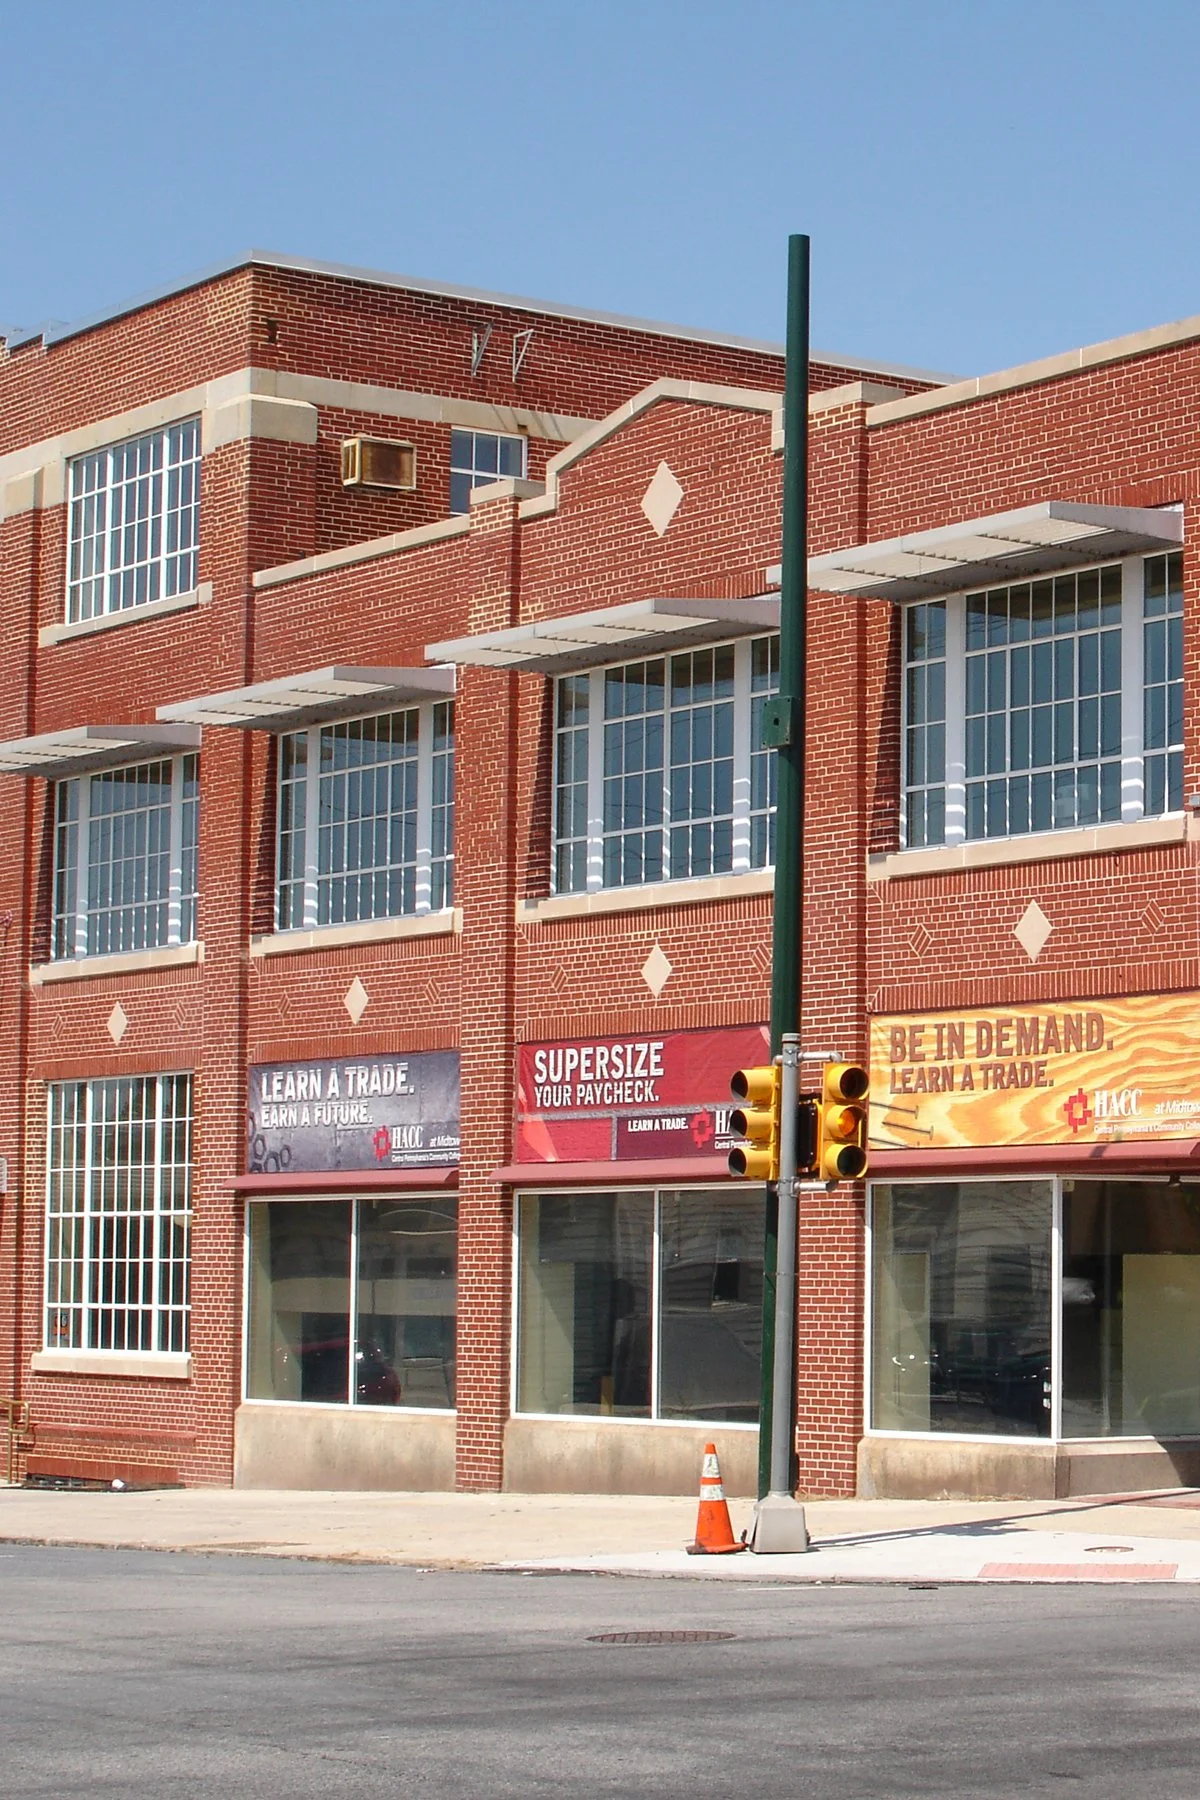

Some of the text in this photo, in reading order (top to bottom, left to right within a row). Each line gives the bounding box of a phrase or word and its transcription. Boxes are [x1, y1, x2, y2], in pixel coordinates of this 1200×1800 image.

[889, 1012, 1114, 1063] BE IN DEMAND.
[534, 1041, 664, 1084] SUPERSIZE
[889, 1060, 1054, 1094] LEARN A TRADE.
[261, 1062, 415, 1102] LEARN A TRADE.
[534, 1079, 660, 1108] YOUR PAYCHECK.
[261, 1100, 373, 1129] EARN A FUTURE.
[1094, 1088, 1143, 1117] HACC
[1154, 1102, 1165, 1115] at
[392, 1125, 460, 1148] HACC at Midtow
[627, 1118, 688, 1132] LEARN A TRADE.
